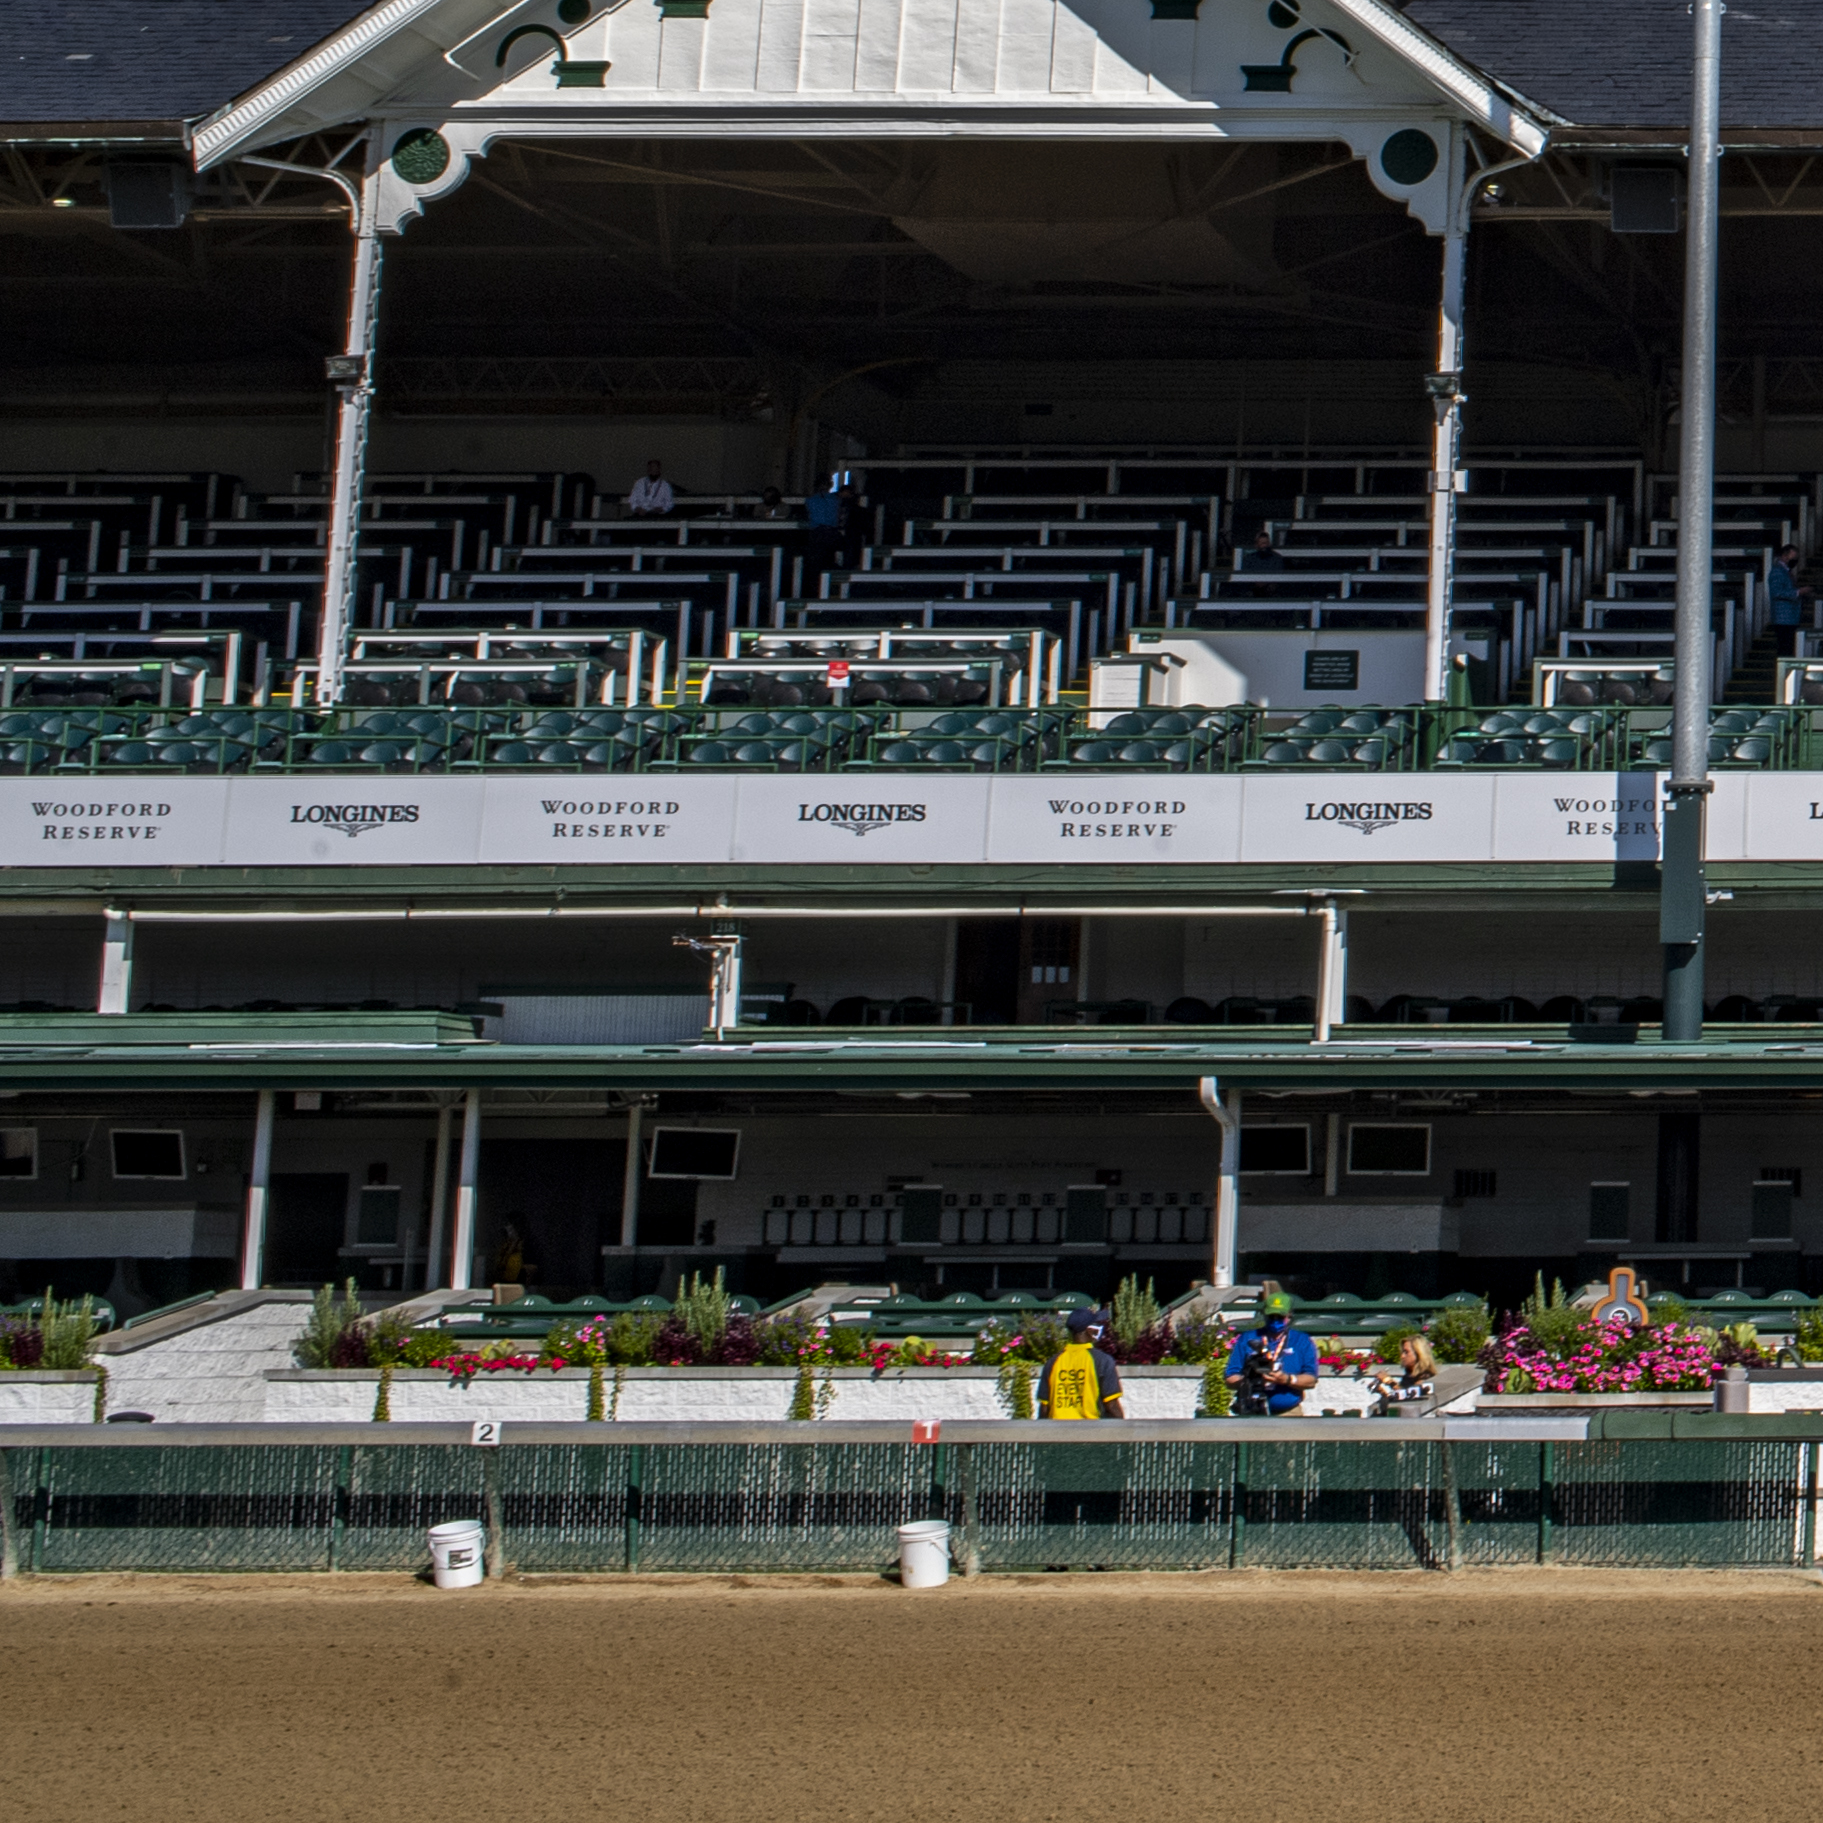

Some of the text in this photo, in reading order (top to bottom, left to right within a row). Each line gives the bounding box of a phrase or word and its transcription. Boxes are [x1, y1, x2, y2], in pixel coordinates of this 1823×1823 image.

[31, 802, 172, 817] WOODFORD
[540, 800, 680, 815] WOODFORD
[798, 803, 926, 822] LONGINES
[1047, 799, 1186, 815] WOODFORD
[1305, 802, 1433, 821] LONGINES
[1553, 797, 1667, 813] WOODFO
[290, 804, 419, 823] LONGINES
[42, 824, 157, 840] RESERVE
[552, 822, 666, 838] RESERVE
[1060, 822, 1172, 838] RESERVE
[1566, 820, 1664, 835] RESERV
[1058, 1369, 1086, 1382] CSC
[478, 1423, 494, 1442] 2
[921, 1420, 934, 1440] 1
